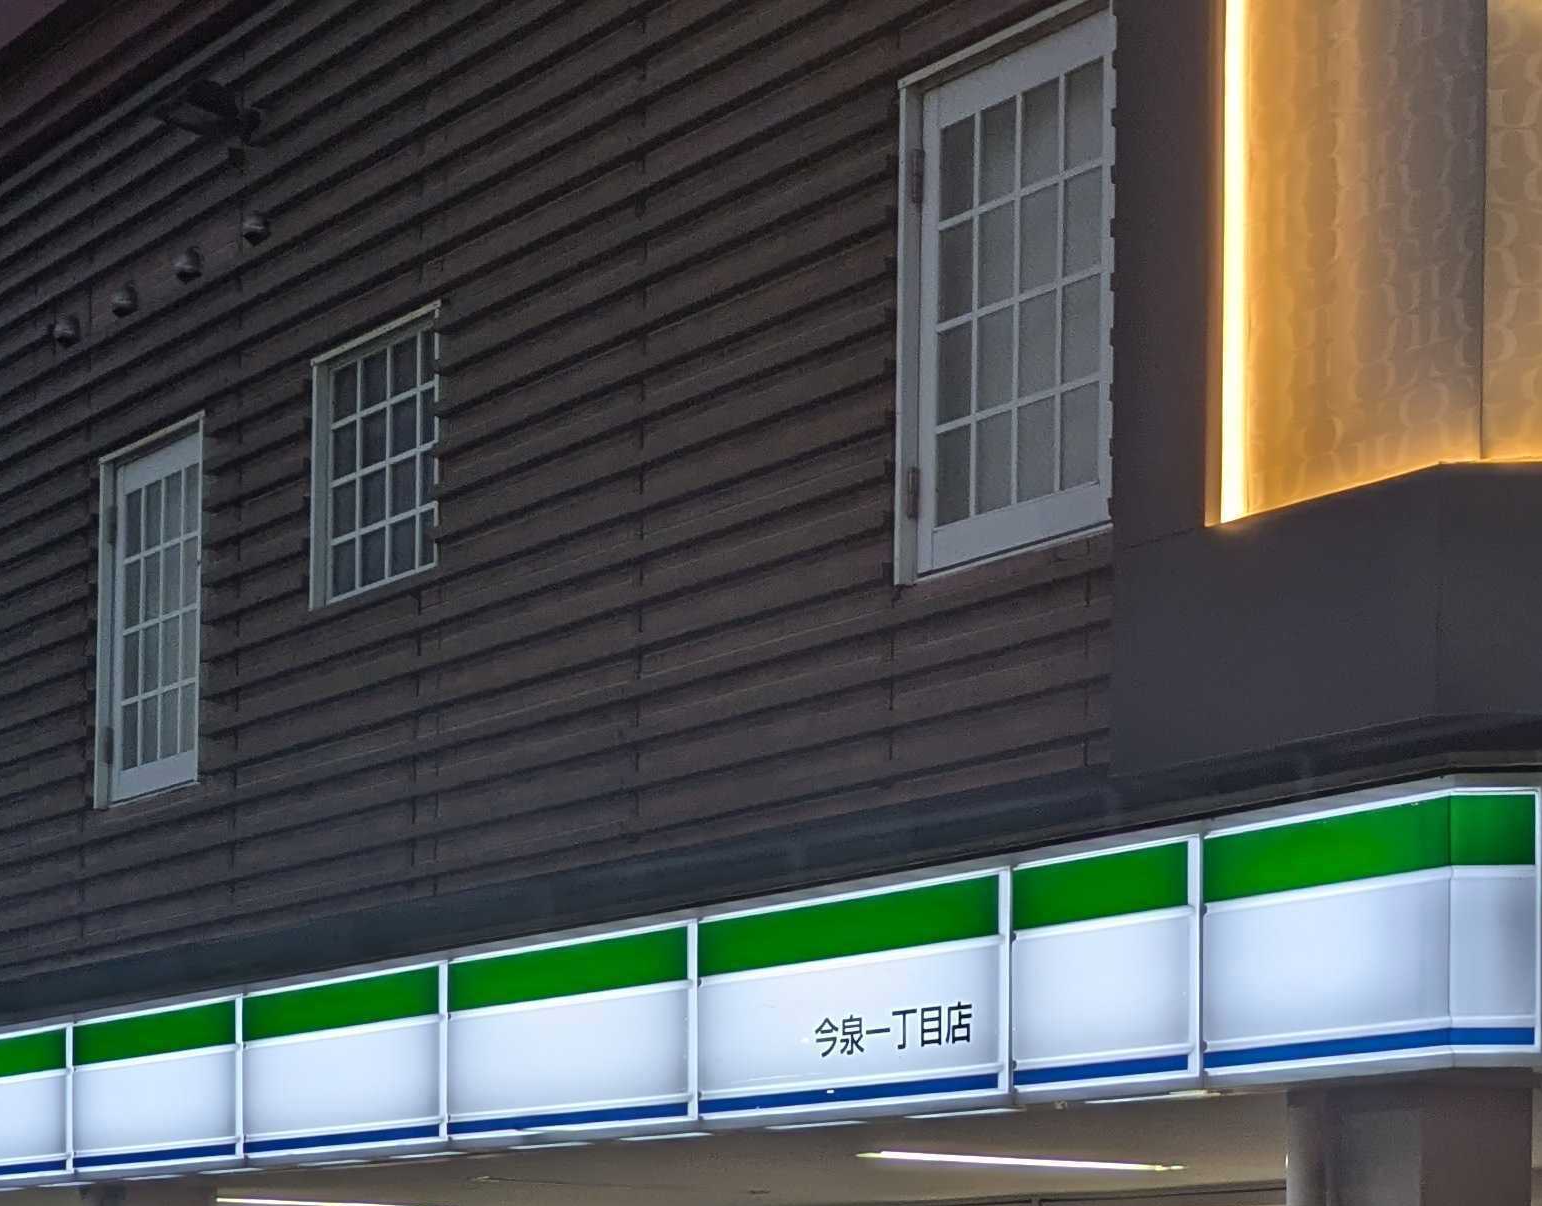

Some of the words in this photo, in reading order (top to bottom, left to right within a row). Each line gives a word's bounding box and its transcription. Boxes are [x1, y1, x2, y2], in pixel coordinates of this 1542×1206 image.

[815, 1001, 972, 1058] 今泉一丁目店
